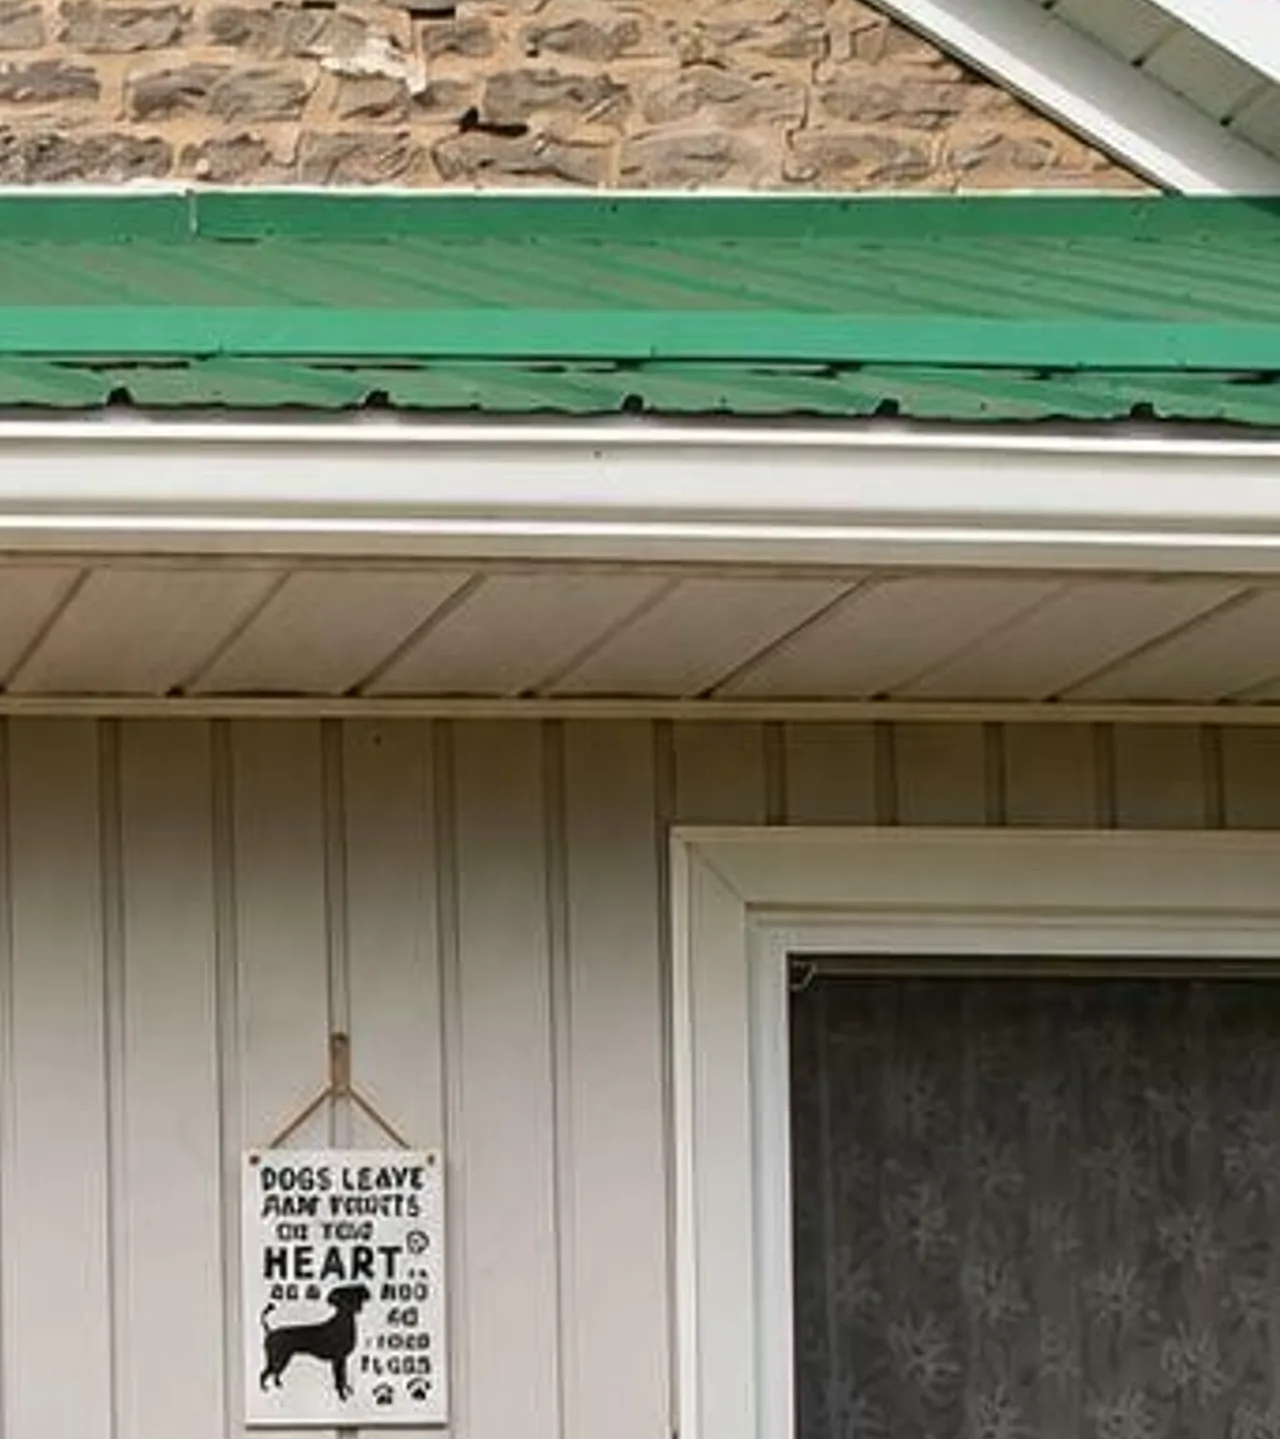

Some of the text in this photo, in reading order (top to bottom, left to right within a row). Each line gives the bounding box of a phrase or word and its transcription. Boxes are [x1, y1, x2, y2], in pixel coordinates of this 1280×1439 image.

[260, 1166, 425, 1191] DOGS LEAVE
[262, 1245, 404, 1281] HEART
